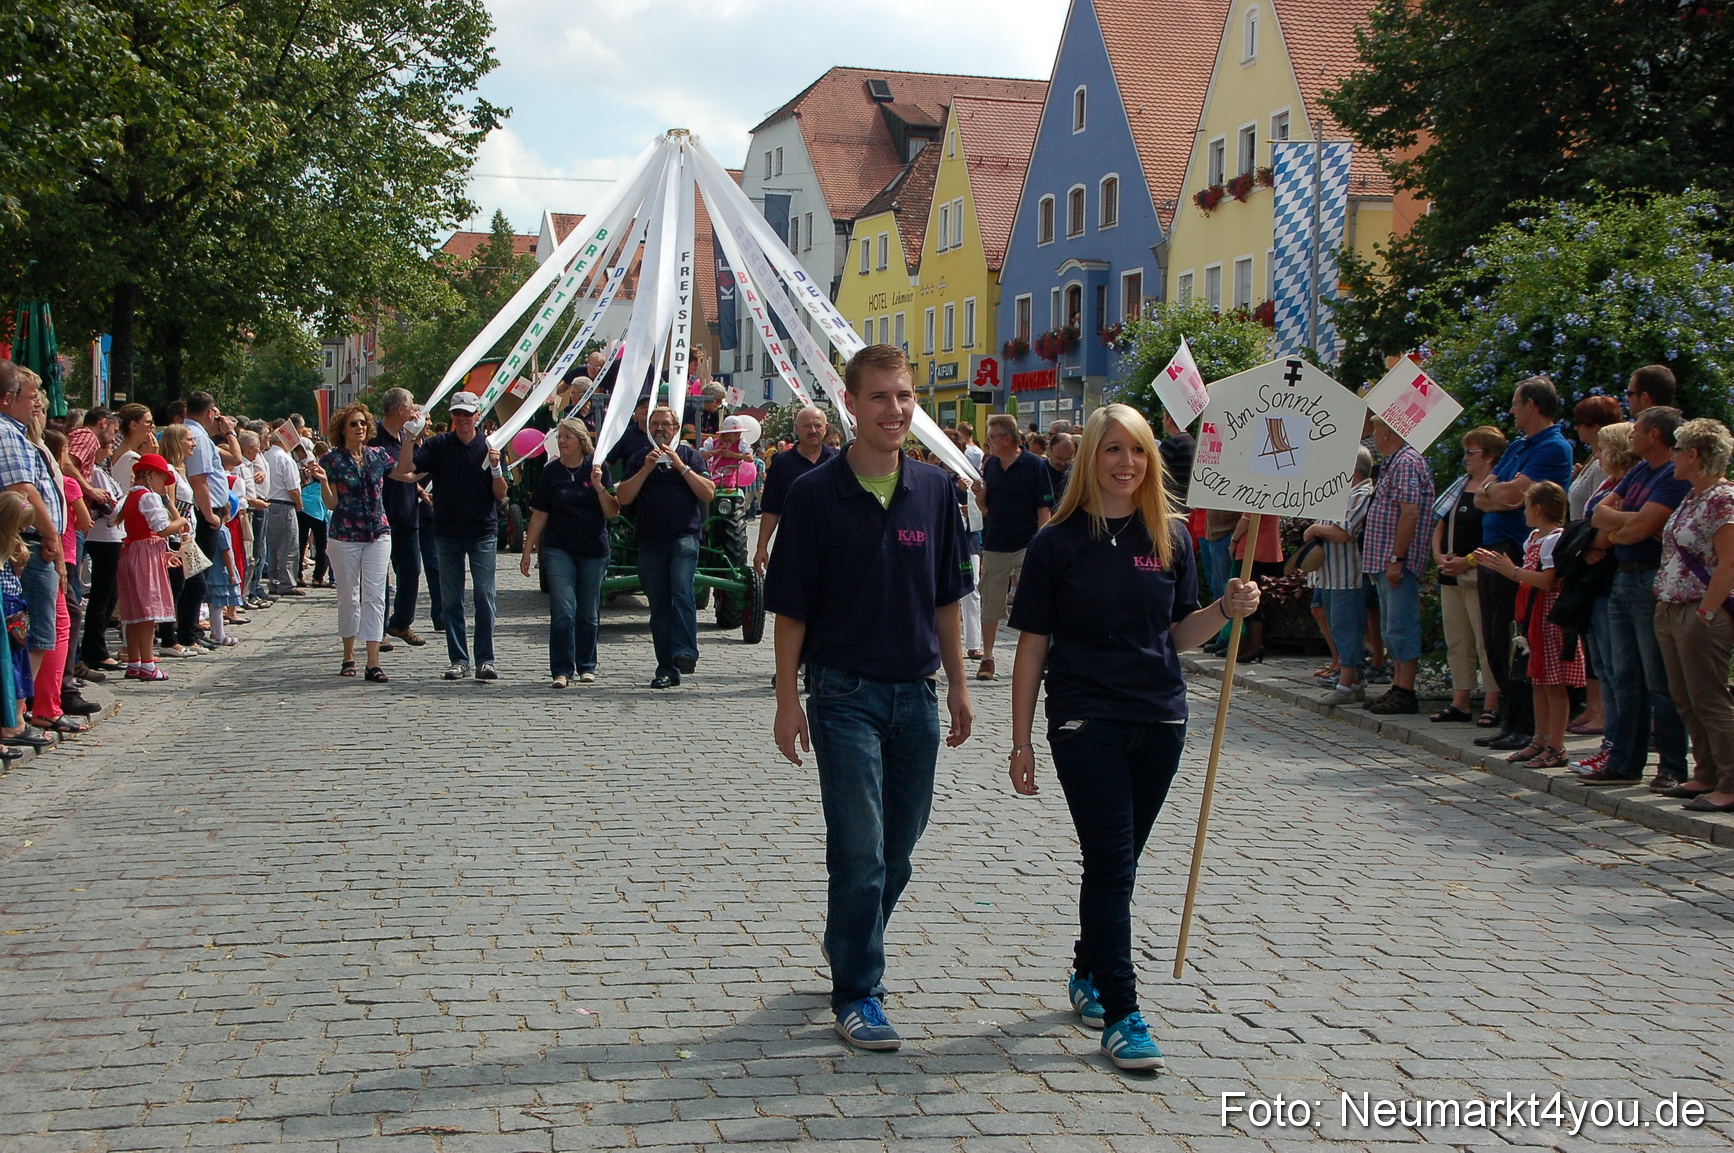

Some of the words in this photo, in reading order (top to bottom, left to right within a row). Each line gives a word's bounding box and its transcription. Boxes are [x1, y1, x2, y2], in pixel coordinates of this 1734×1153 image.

[674, 251, 690, 375] FREYSTADT
[868, 292, 888, 311] HOTEL
[553, 267, 625, 376] DIETFURT
[1223, 407, 1255, 440] Am
[1255, 384, 1337, 441] Sonntag
[1380, 410, 1410, 438] BEWEGUNG
[1192, 466, 1231, 496] san
[1232, 483, 1272, 509] mir
[1272, 471, 1353, 516] dahoam
[897, 529, 926, 542] KAB
[1133, 556, 1164, 568] KAB
